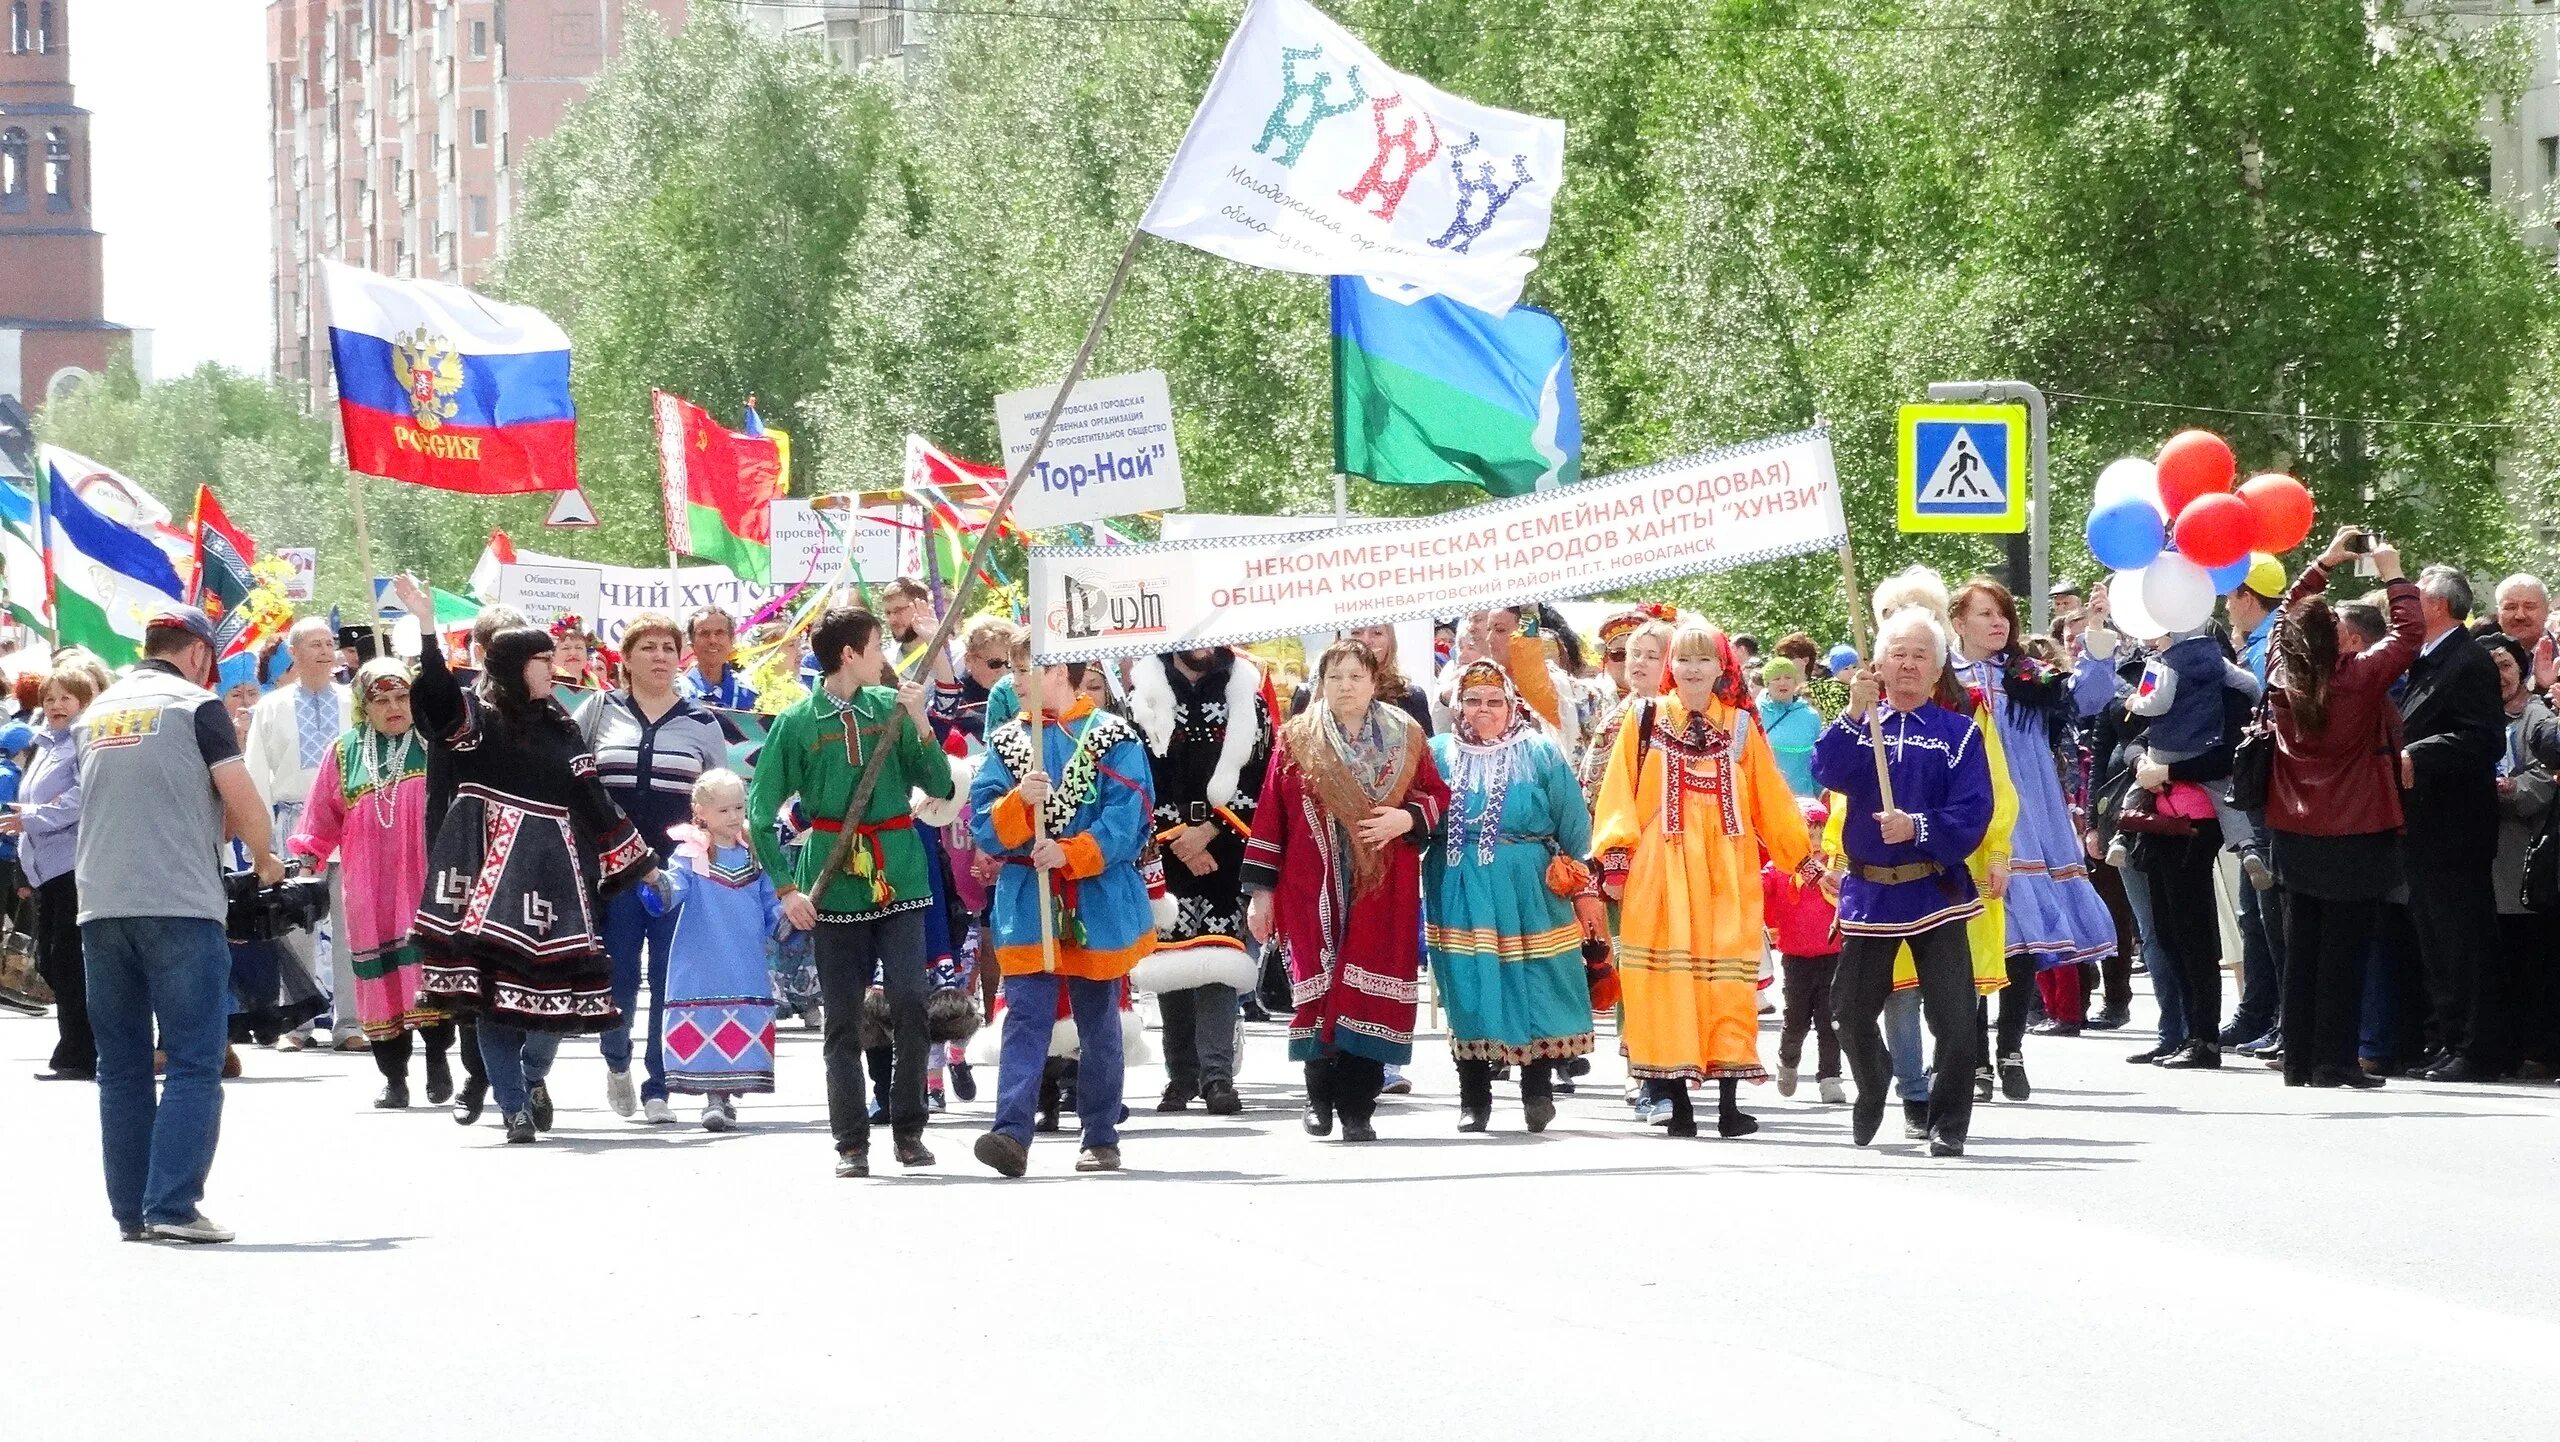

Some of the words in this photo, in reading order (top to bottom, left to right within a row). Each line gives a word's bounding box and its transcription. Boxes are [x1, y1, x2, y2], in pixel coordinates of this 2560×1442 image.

[1100, 396, 1145, 411] ГОРОДСКАЯ
[1030, 419, 1088, 437] ОБСТВЕННАЯ
[1091, 411, 1144, 428] ОРГАНИЗАЦИЯ
[1056, 428, 1125, 448] ПРОСВЕТИТЕЛЬНОЕ
[1127, 423, 1167, 438] ОБЩЕСТВО
[394, 426, 482, 461] РОССИЯ
[1246, 528, 1497, 579] НЕКОММЕРЧЕСКАЯ
[1505, 495, 1645, 542] СЕМЕЙНАЯ
[1652, 460, 1790, 515] (РОДОВАЯ)
[1211, 577, 1333, 608] ОБЩИНА
[1341, 557, 1486, 592] КОРЕННЫХ
[1495, 530, 1619, 571] НАРОДОВ
[1626, 508, 1714, 544] ХАНТЫ
[1722, 481, 1828, 521] “ХУНЗИ”
[525, 573, 576, 586] Общество
[1334, 578, 1502, 615] НИЖНЕВАРТОВСКИЙ
[1507, 571, 1561, 590] РАЙОН
[1567, 560, 1606, 578] П.Г.Т.
[1611, 537, 1716, 569] НОВОАГАНСК
[519, 589, 580, 600] молдавской
[525, 603, 571, 613] культуры
